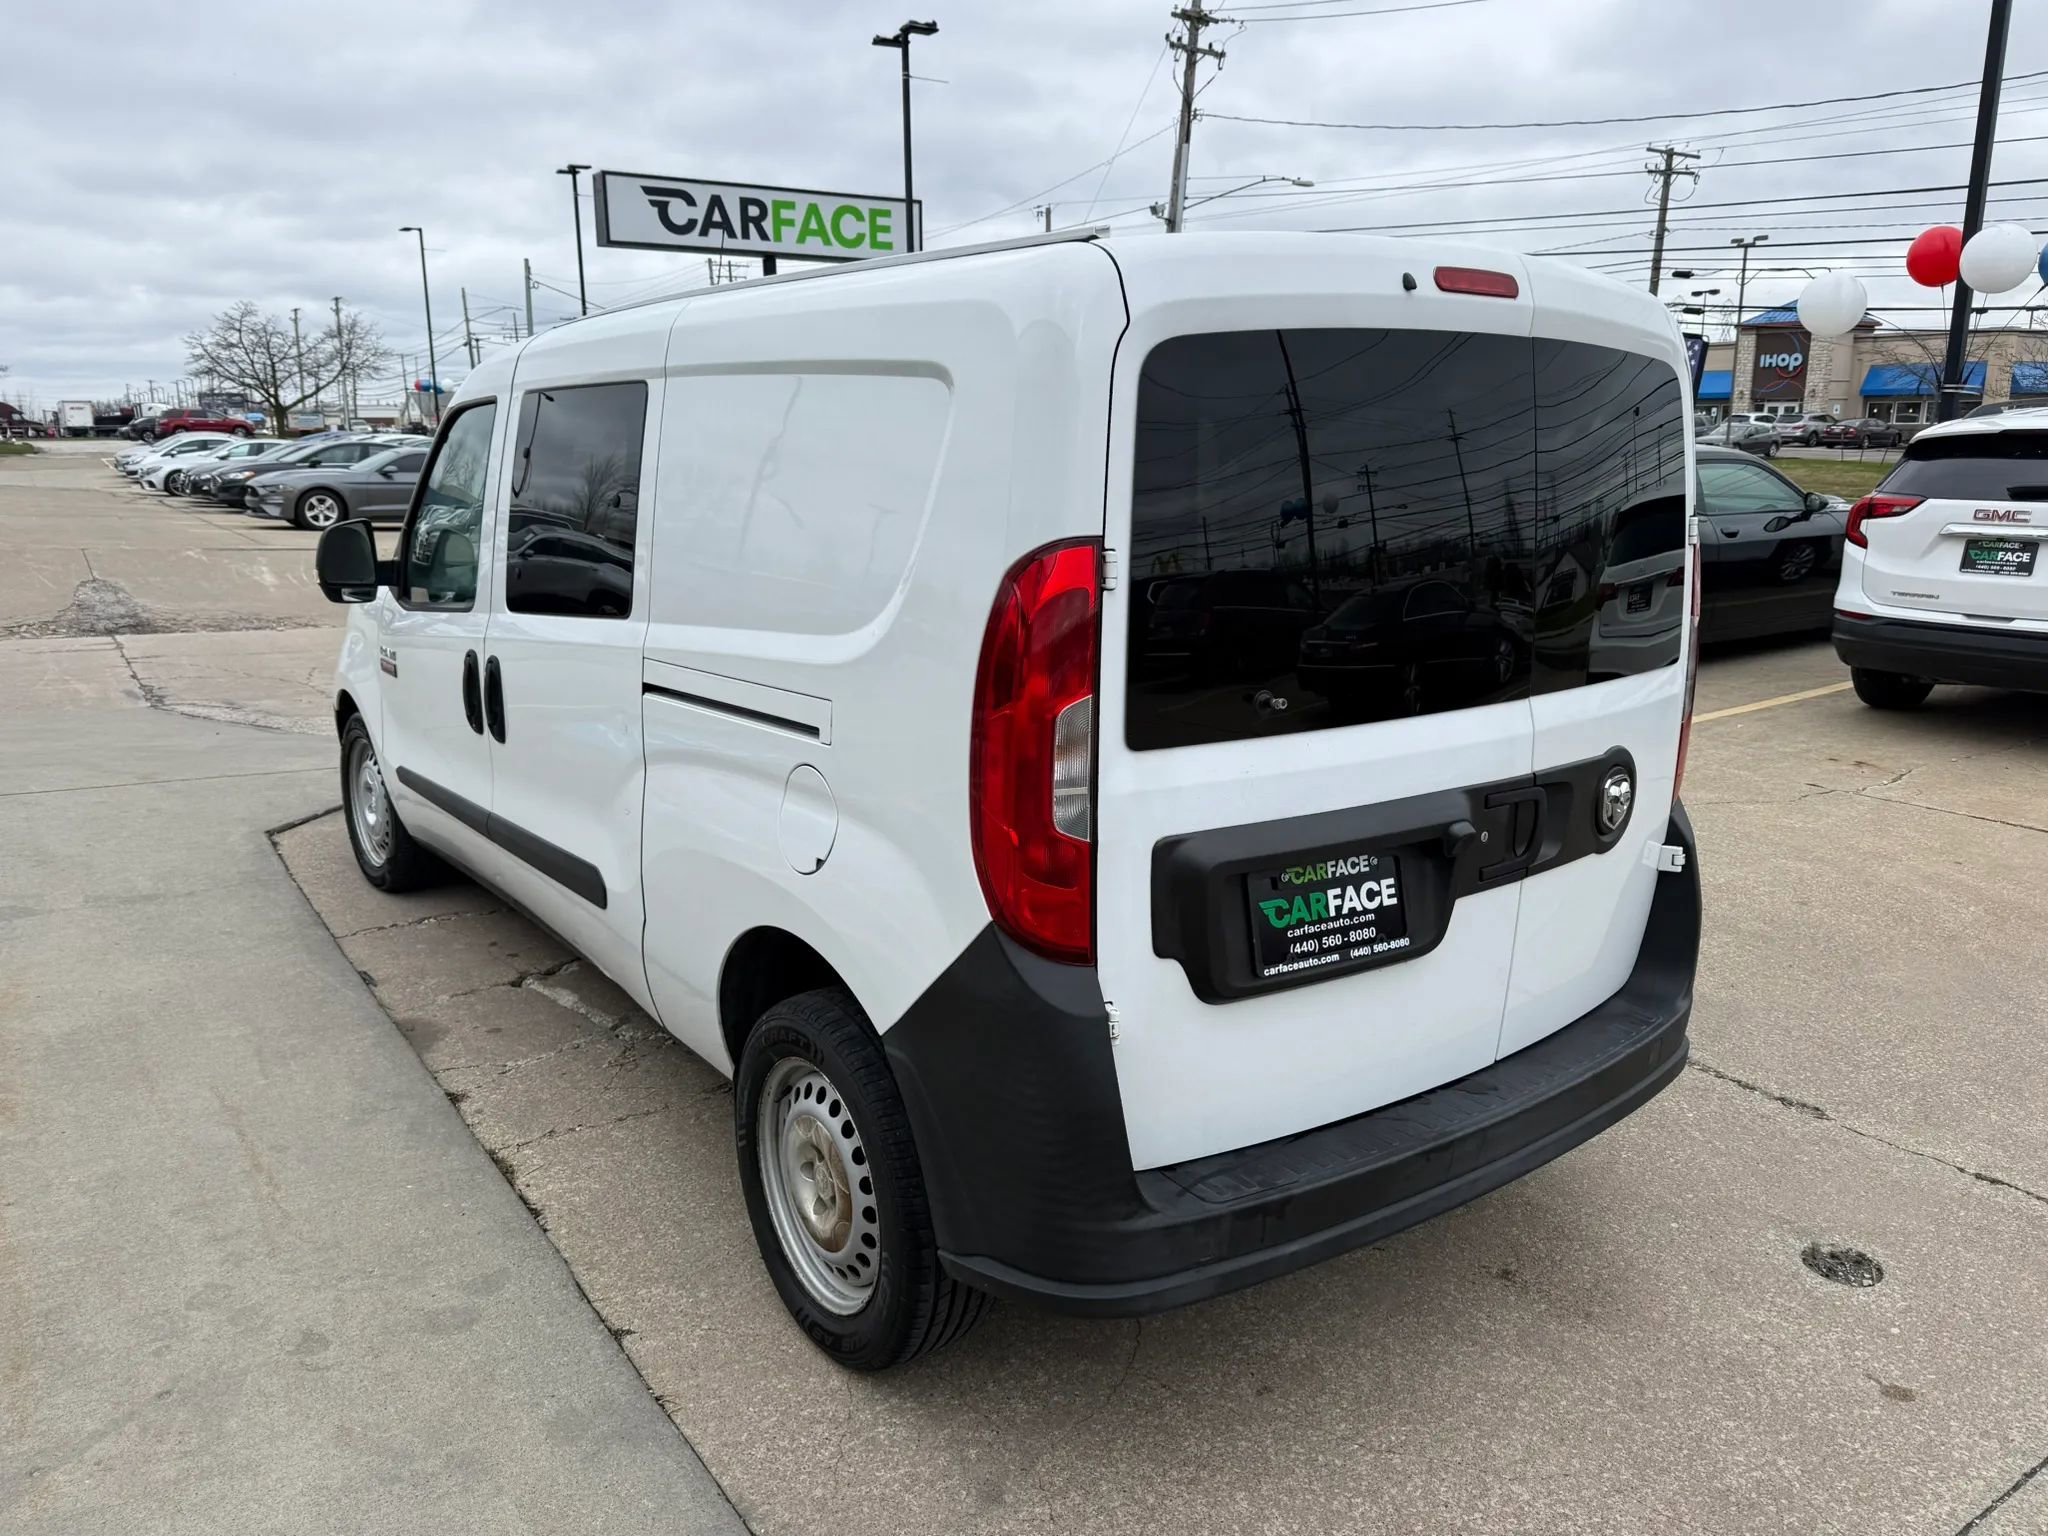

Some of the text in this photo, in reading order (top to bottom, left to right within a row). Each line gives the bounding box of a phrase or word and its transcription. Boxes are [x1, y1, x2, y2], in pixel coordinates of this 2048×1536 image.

[640, 185, 894, 250] CARFACE
[1760, 353, 1803, 371] IHOP
[1973, 509, 2032, 523] GMC
[1968, 550, 2031, 562] CARFACE
[1286, 855, 1370, 885] CARFACE
[1258, 877, 1398, 929] CARFACE
[1287, 913, 1376, 938] carfaceauto.com
[1264, 937, 1410, 976] carfaceauto.com (440) 560-8080
[1290, 938, 1319, 955] (440)
